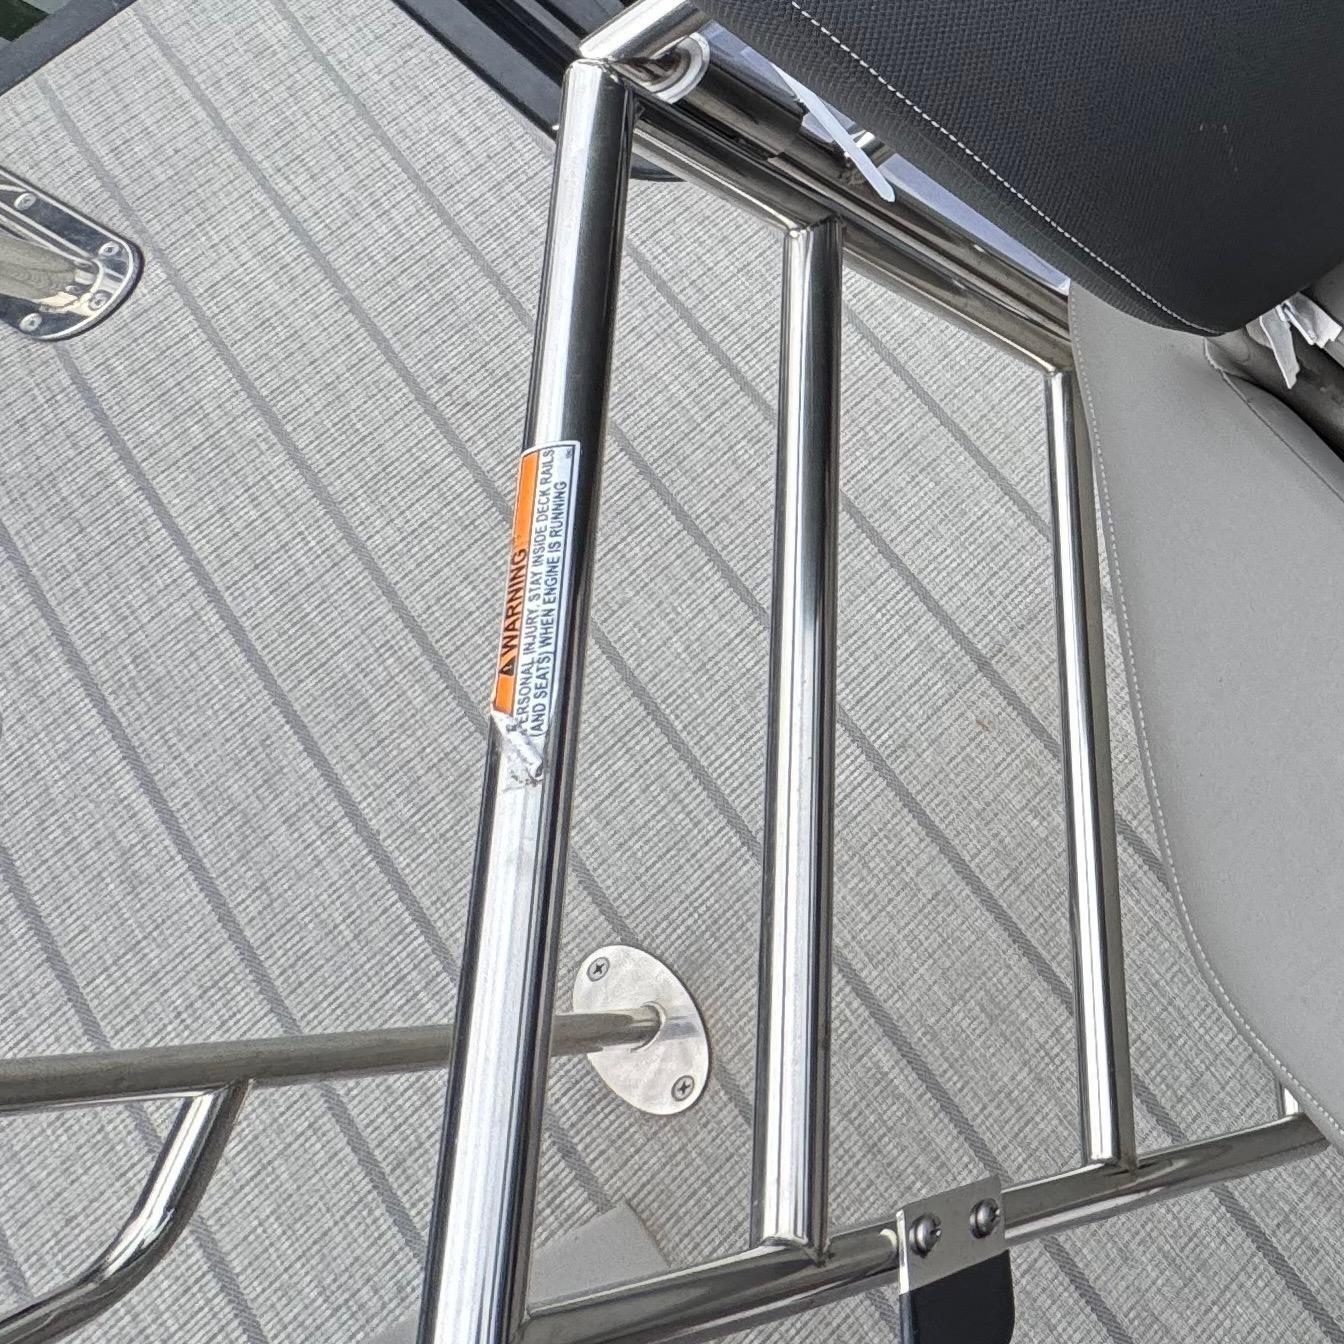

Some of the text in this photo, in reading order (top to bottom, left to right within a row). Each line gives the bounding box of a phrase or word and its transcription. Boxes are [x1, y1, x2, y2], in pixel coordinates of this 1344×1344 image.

[539, 447, 555, 485] RAILS
[536, 487, 551, 523] DECK
[531, 525, 548, 567] INSIDE
[499, 548, 528, 656] WARNING
[528, 571, 543, 602] STAY
[529, 481, 568, 739] (AND SEATS) WHEN ENGINE IS RUNNING
